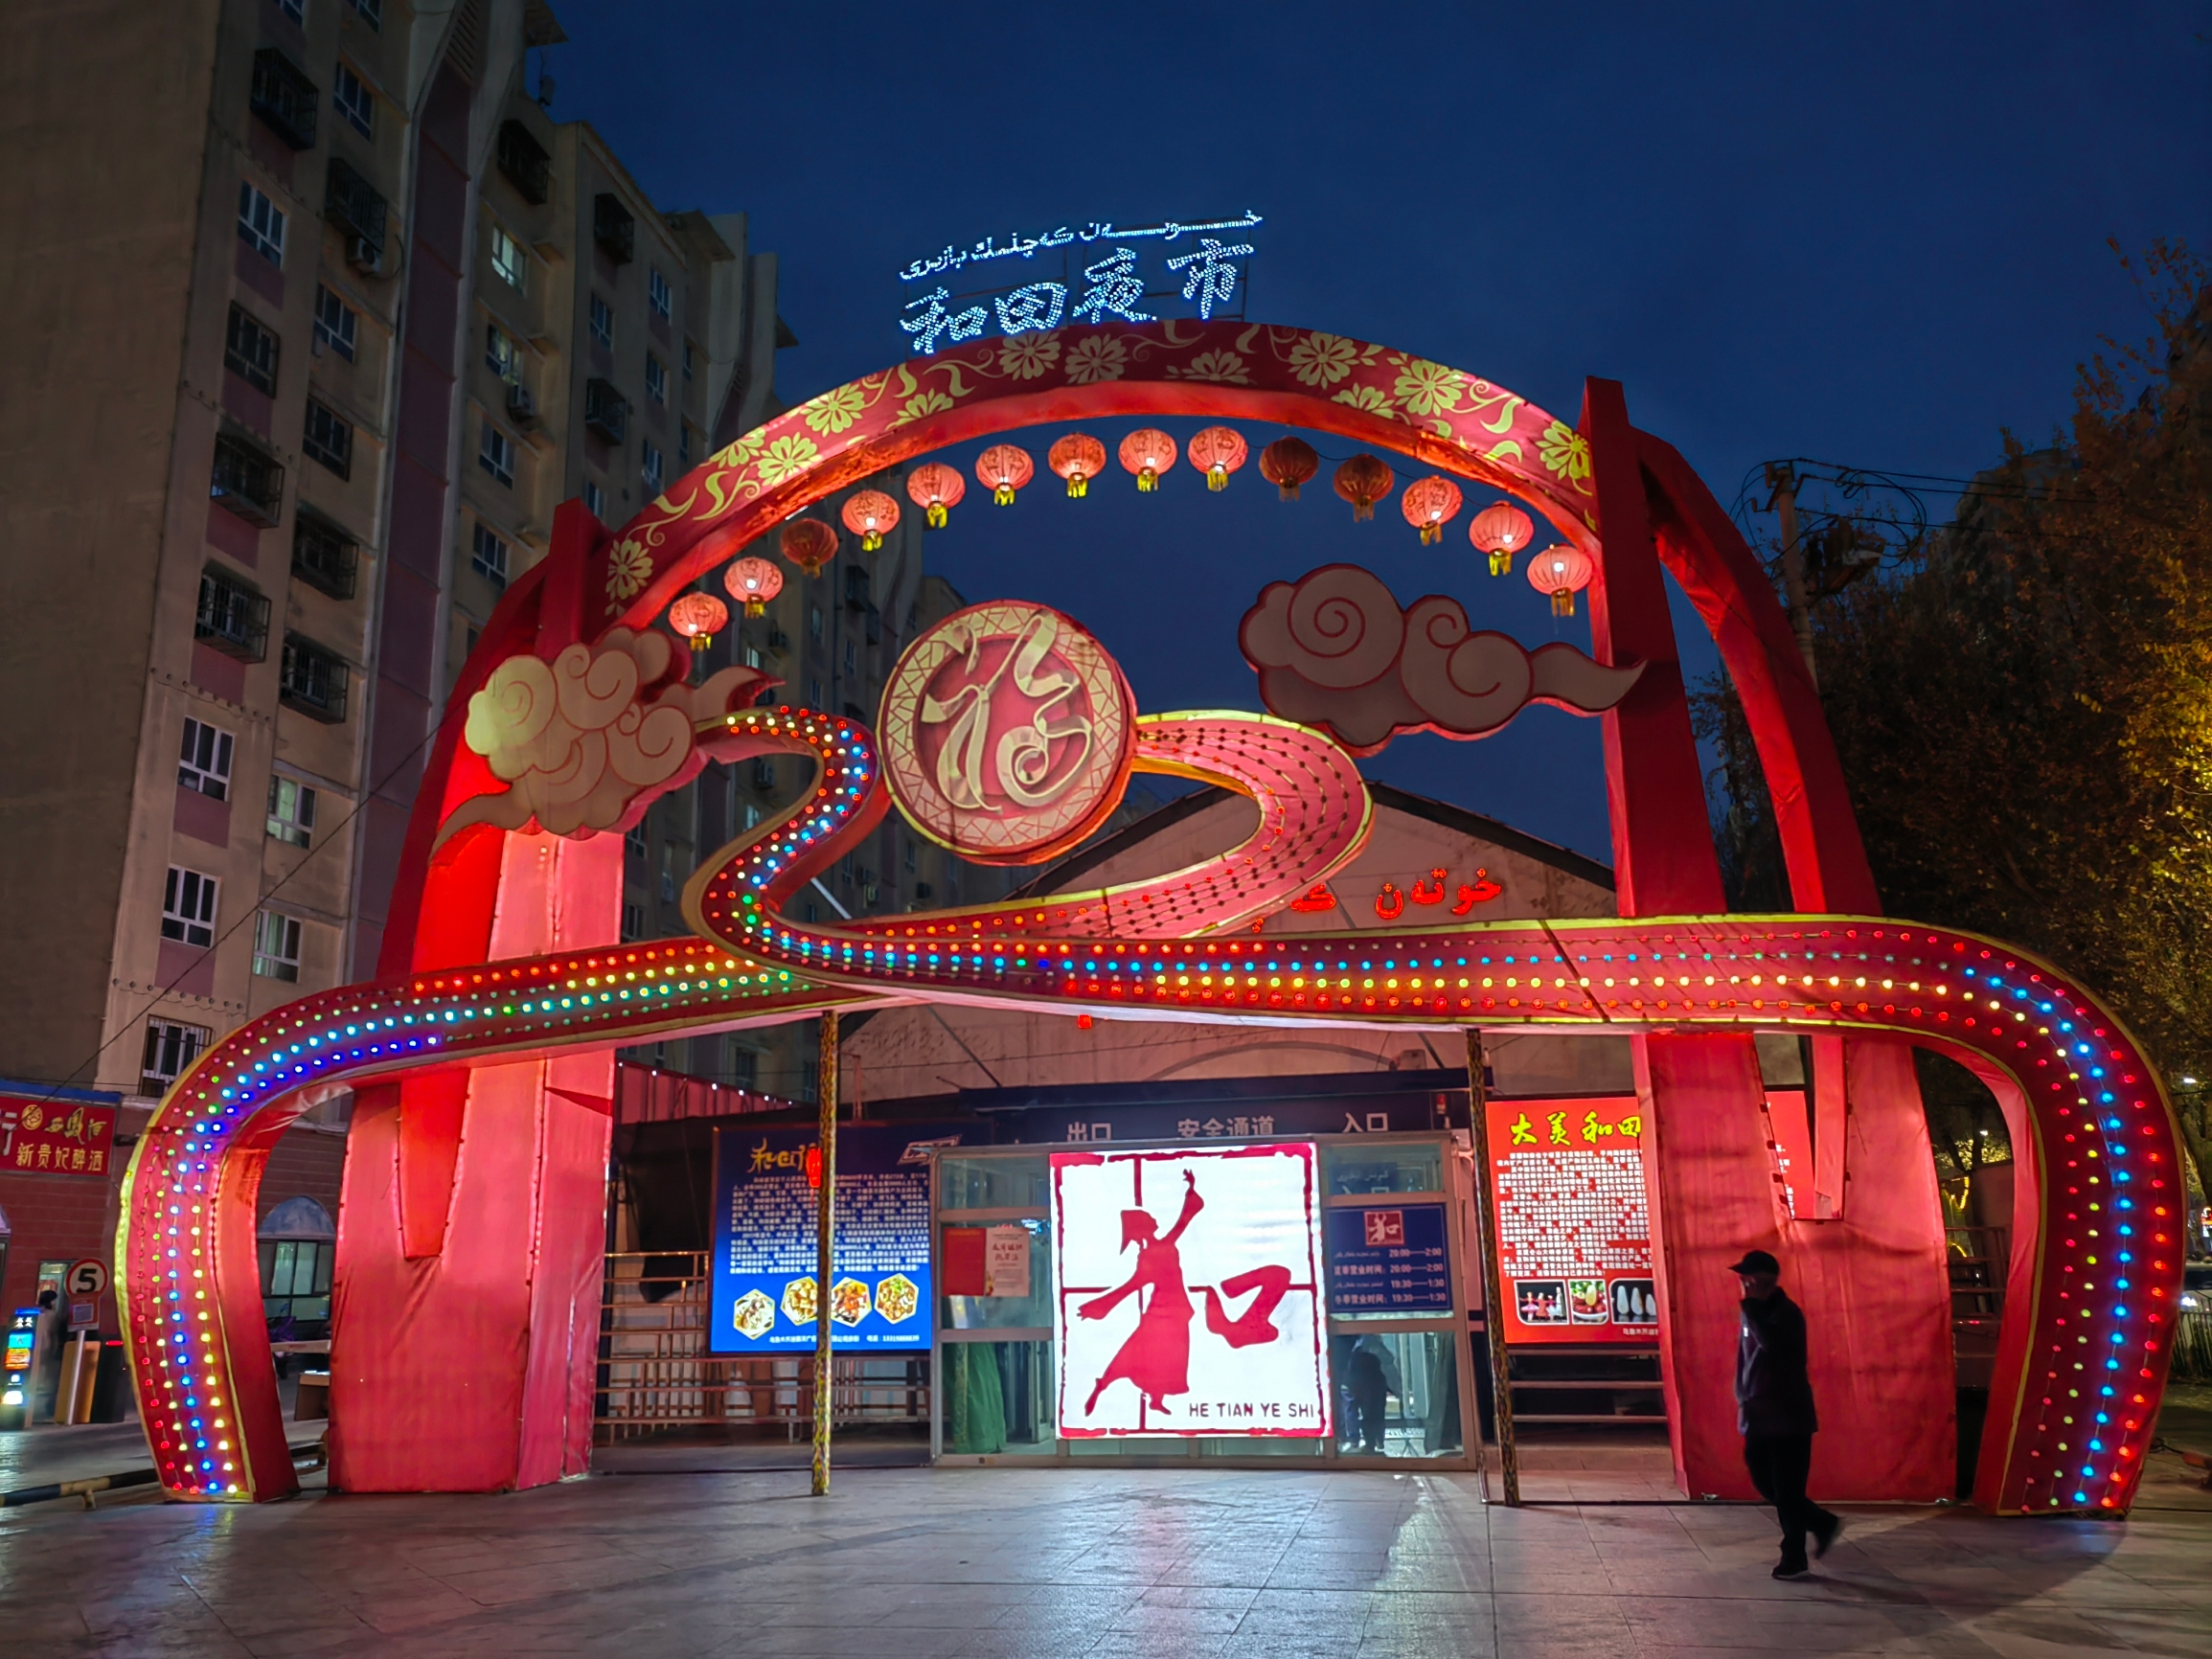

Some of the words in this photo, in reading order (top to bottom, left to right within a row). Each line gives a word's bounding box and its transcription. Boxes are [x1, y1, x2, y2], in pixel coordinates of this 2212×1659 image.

[899, 238, 1256, 354] 和田夜市
[1066, 1121, 1112, 1142] 出口
[1176, 1115, 1275, 1139] 安全通道
[1343, 1111, 1388, 1133] 入口
[1509, 1110, 1643, 1148] 大美和田
[16, 1142, 104, 1171] 新贵妃醉酒
[76, 1267, 98, 1294] 5
[1189, 1402, 1209, 1417] HE
[1216, 1402, 1253, 1417] TIAN
[1260, 1402, 1281, 1418] YE
[1288, 1402, 1314, 1418] SHI
